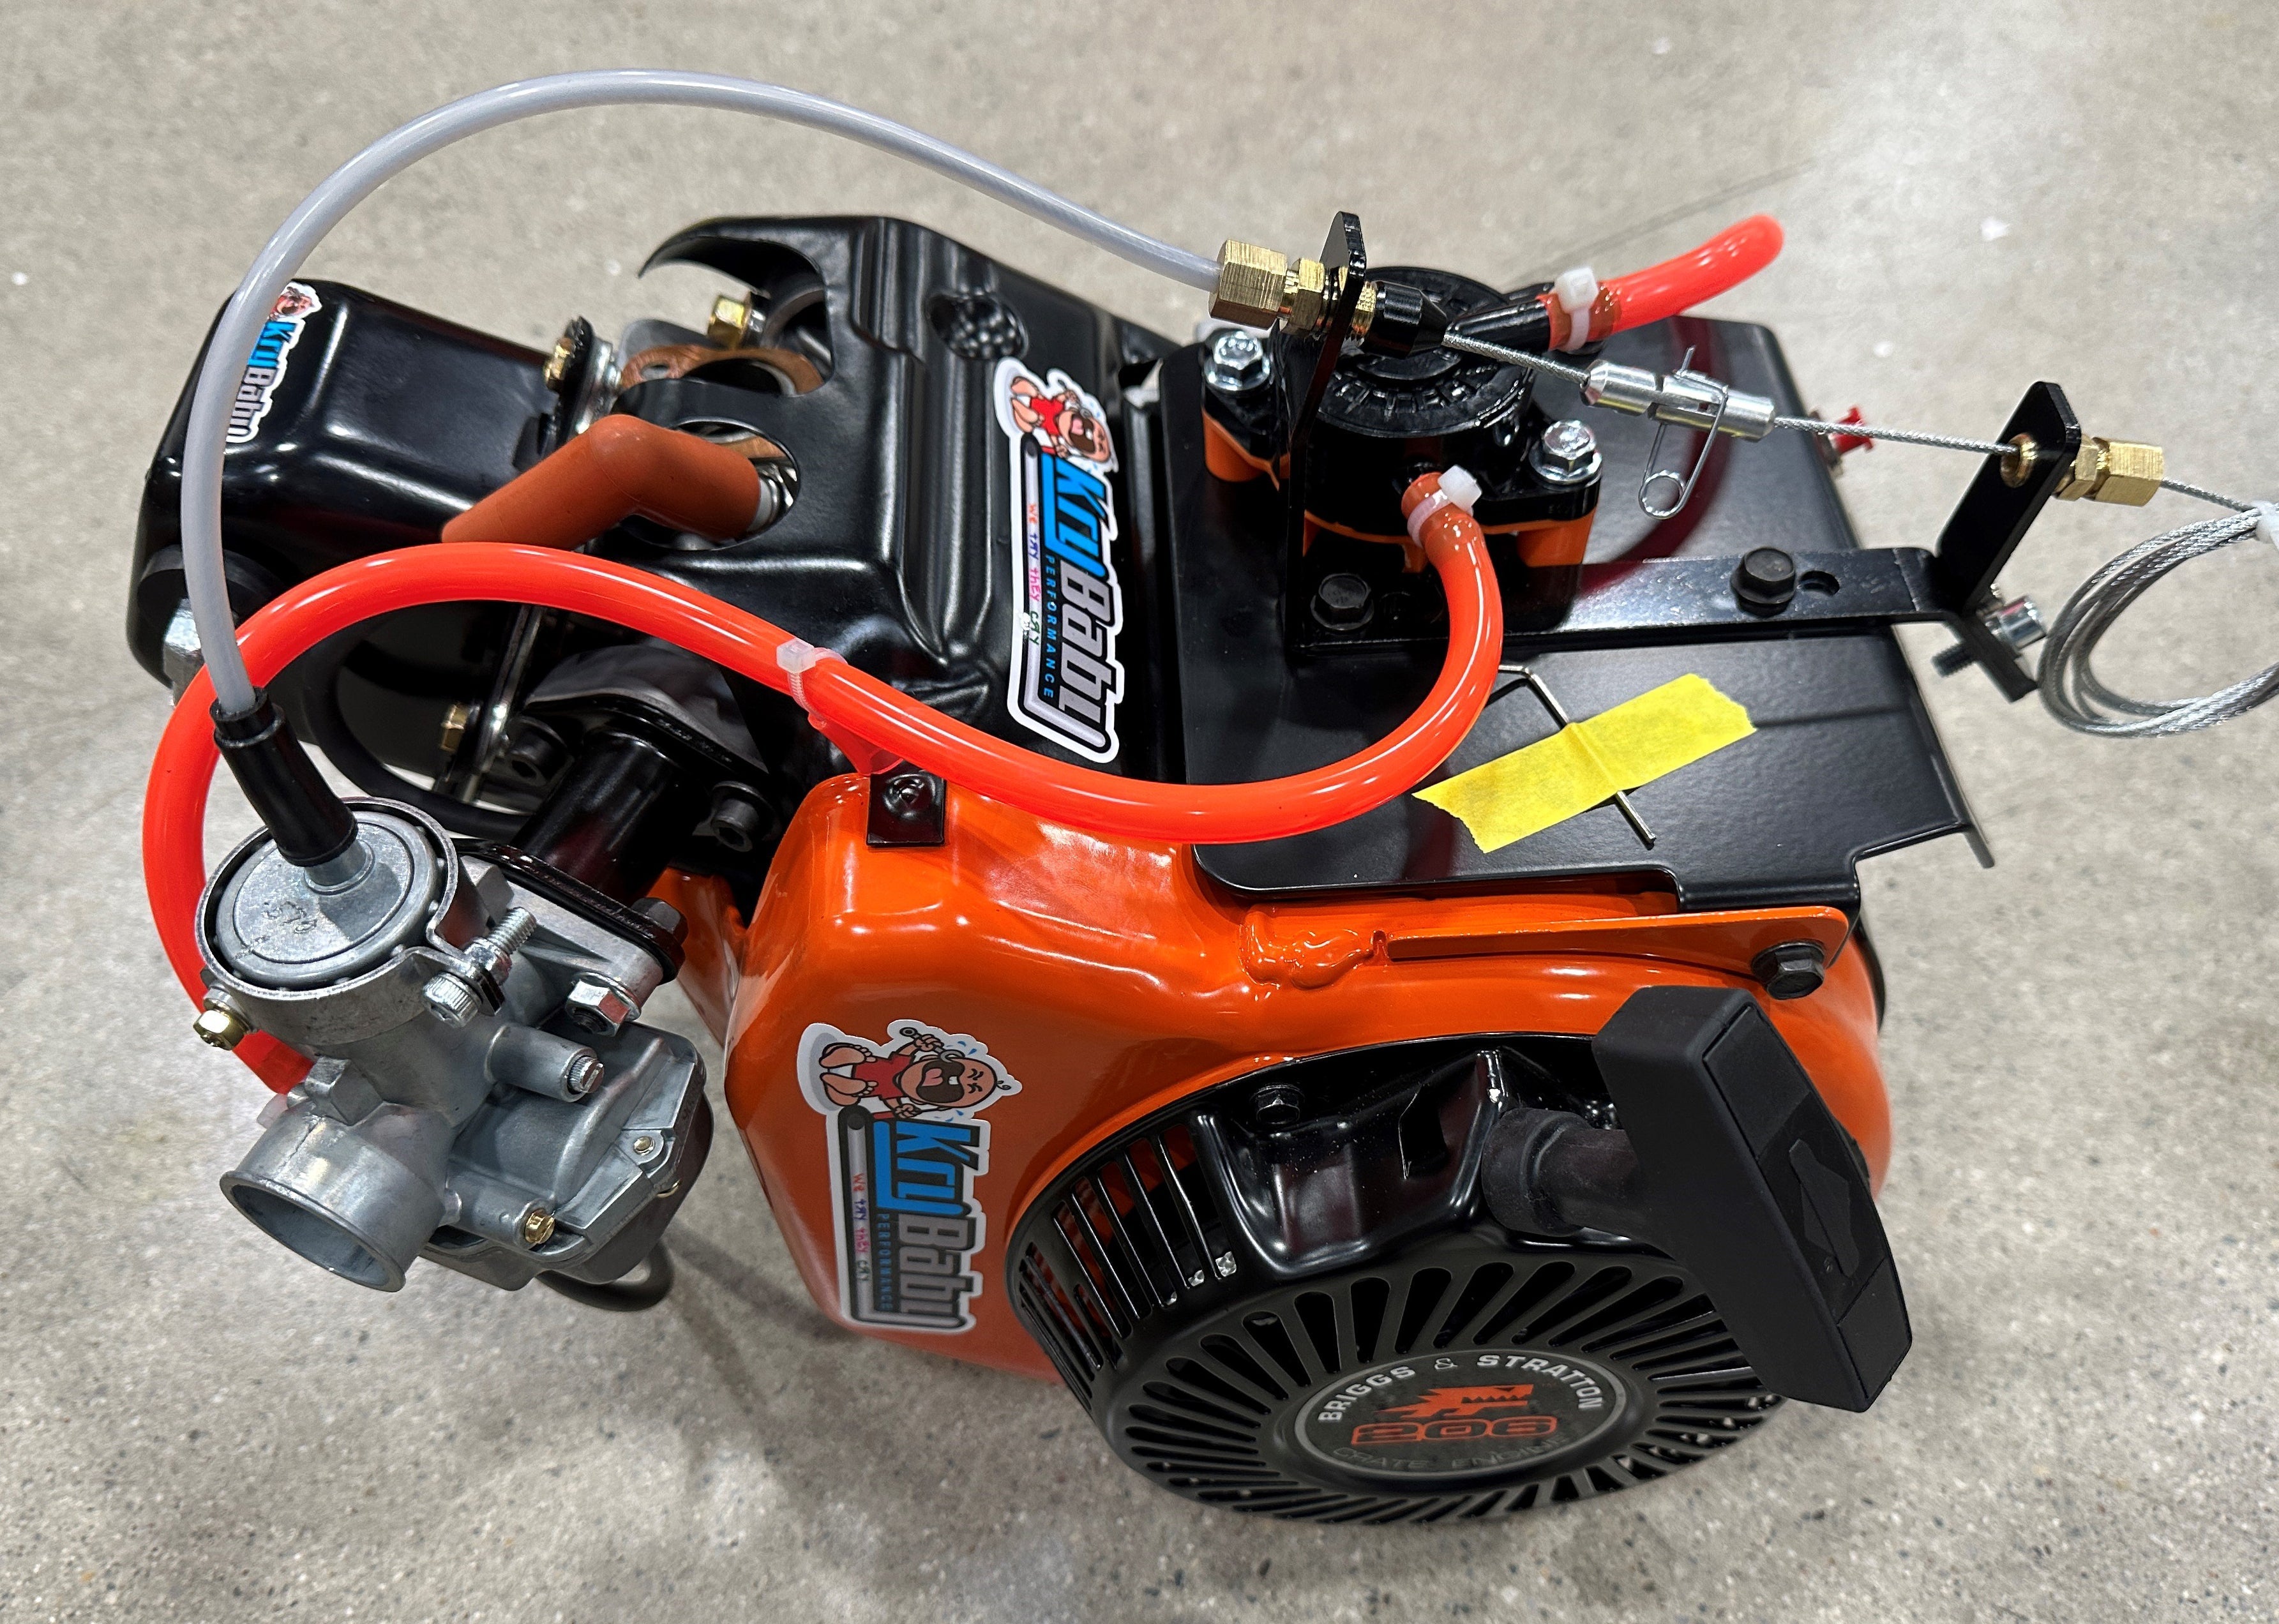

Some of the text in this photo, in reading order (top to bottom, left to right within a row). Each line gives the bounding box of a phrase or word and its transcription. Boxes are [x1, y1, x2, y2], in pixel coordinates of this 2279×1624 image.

[1043, 554, 1057, 699] PERFORMANCE
[876, 1213, 892, 1311] PERFORMANCE
[1318, 1354, 1604, 1423] BRIGGS & STRATTON
[1333, 1447, 1429, 1469] CRATE
[1351, 1415, 1558, 1446] 206
